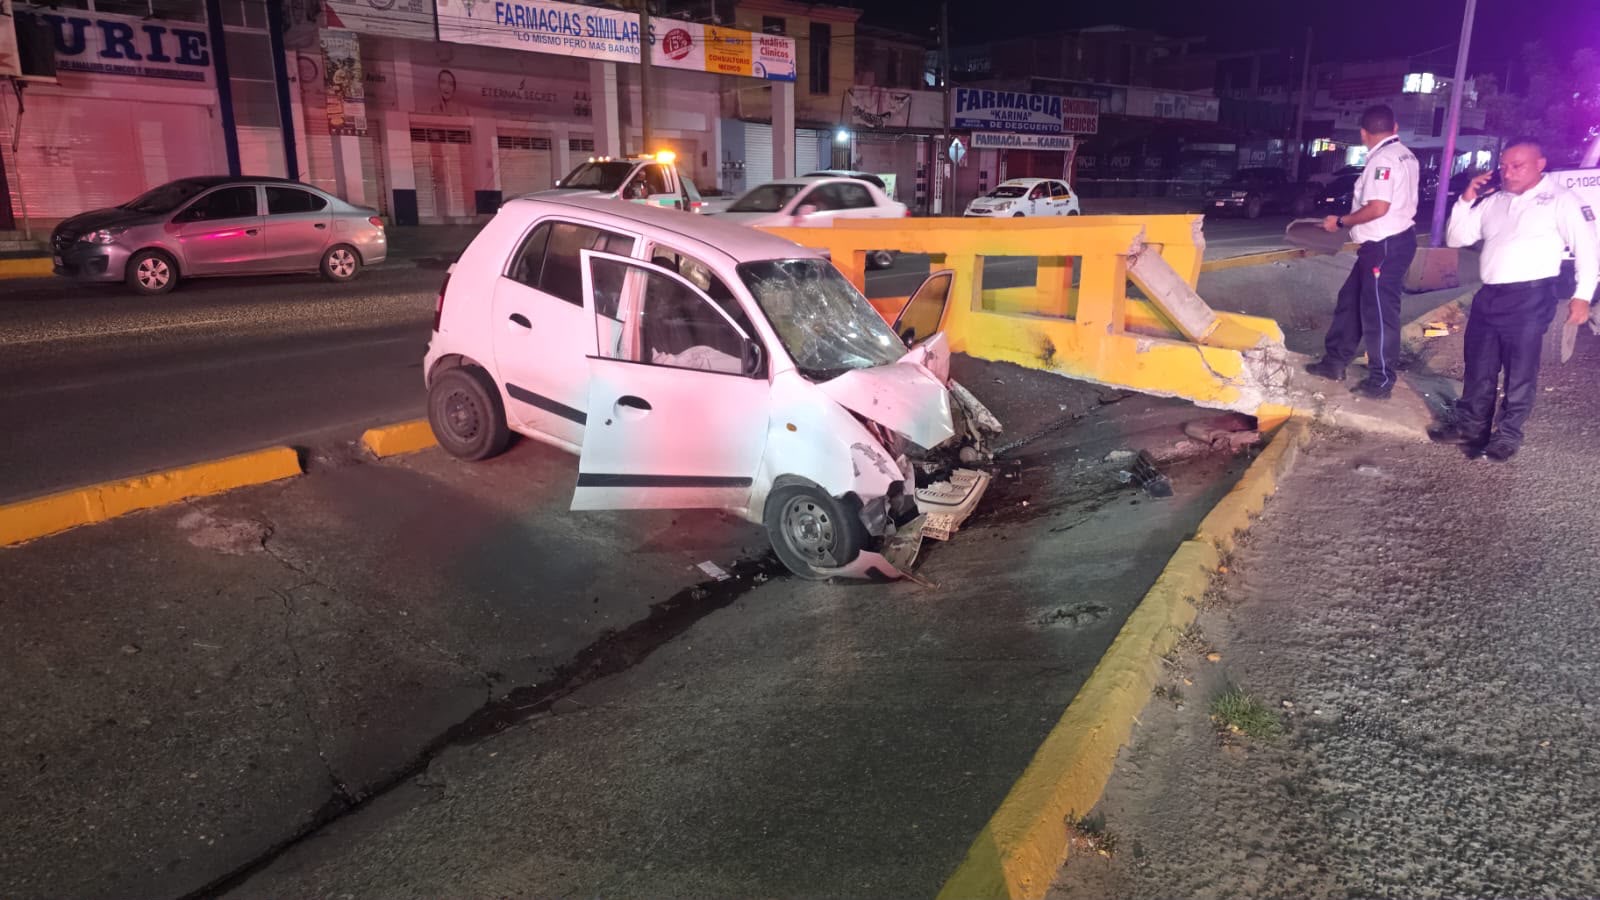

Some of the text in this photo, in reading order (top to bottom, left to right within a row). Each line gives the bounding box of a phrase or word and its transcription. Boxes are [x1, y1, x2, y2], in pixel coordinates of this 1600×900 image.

[496, 2, 656, 46] FARMACIAS SIMILARS
[44, 14, 210, 66] URIE
[532, 34, 561, 46] MISMO
[563, 37, 587, 49] PERO
[481, 87, 558, 102] ETERNAL SECRET
[956, 88, 1062, 119] FARMACIA
[989, 121, 1001, 129] DE
[1005, 122, 1060, 132] DESCUENTO
[975, 134, 1021, 146] FARMACIA
[1037, 137, 1071, 148] KARINA
